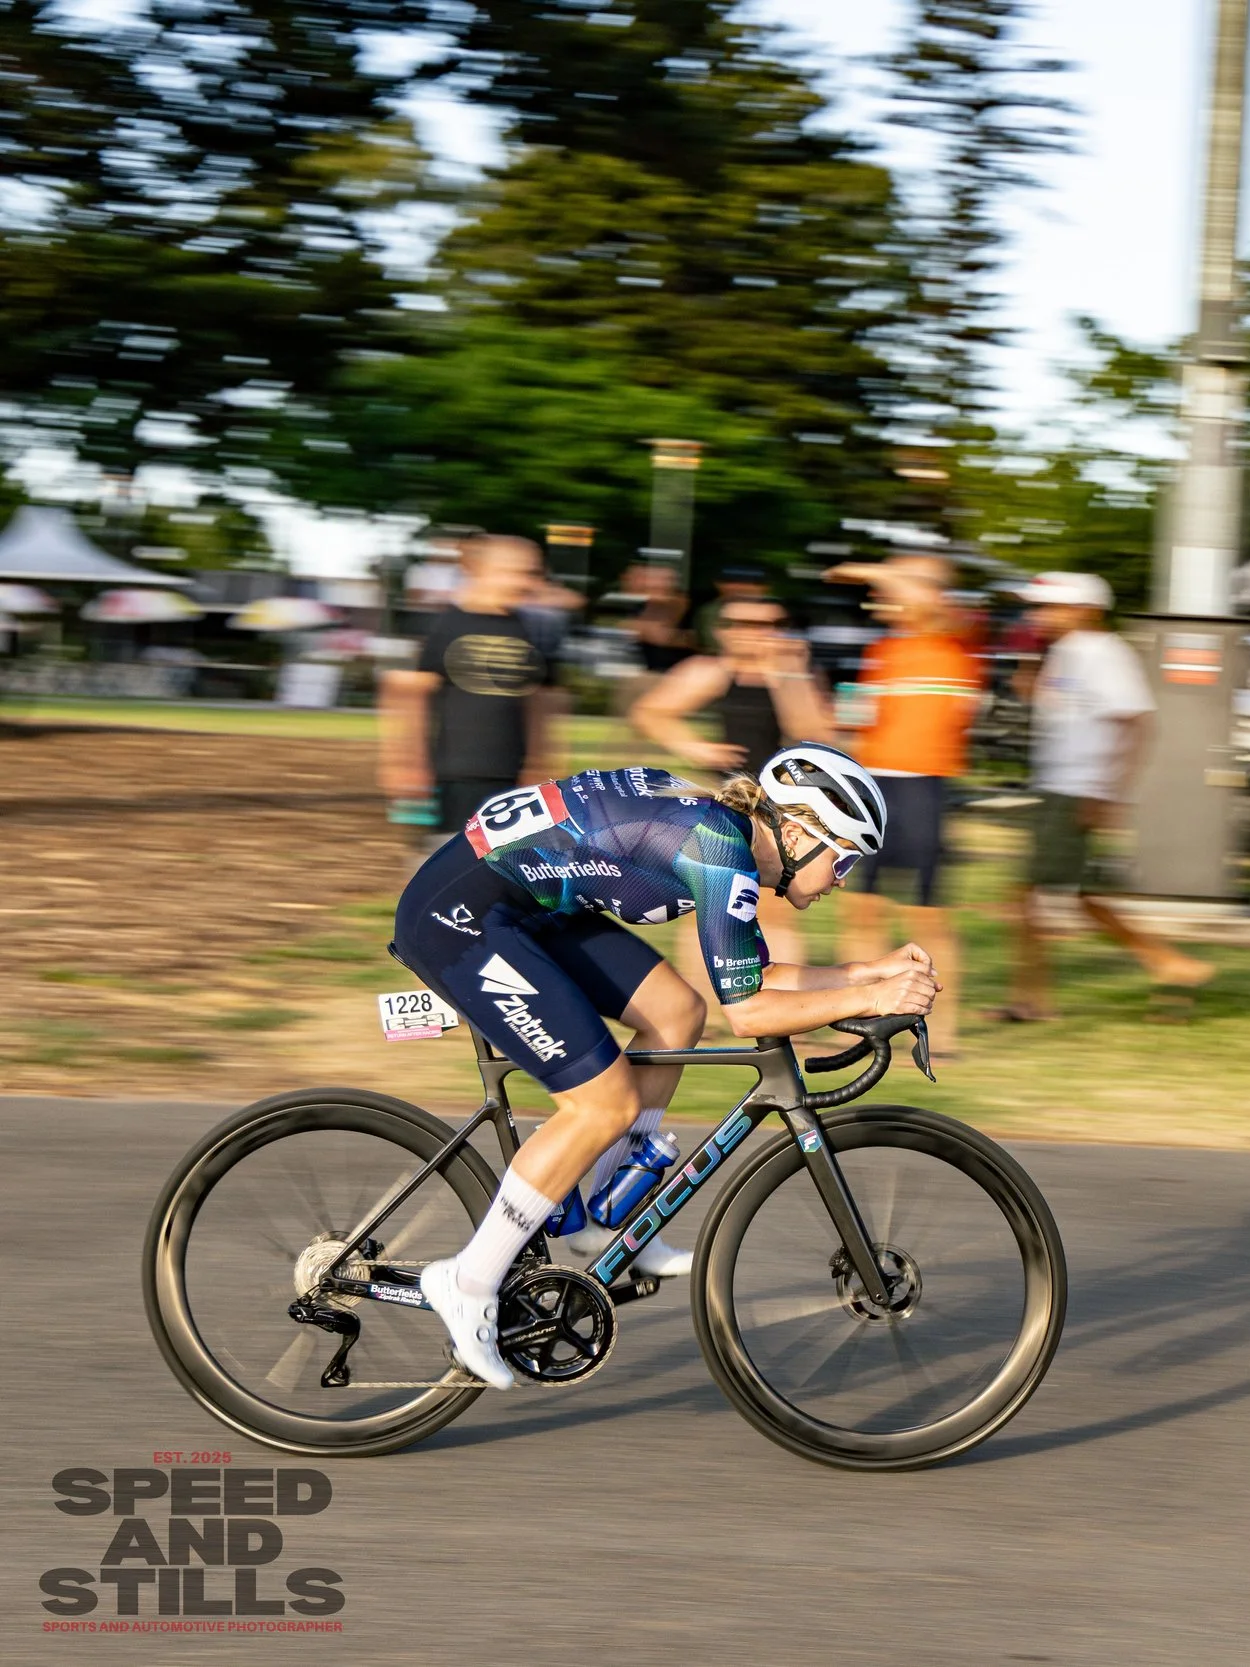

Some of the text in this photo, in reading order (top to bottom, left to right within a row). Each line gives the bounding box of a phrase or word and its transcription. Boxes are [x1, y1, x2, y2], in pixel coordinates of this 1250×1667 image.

[624, 766, 653, 798] ptrak
[481, 791, 545, 832] 65
[519, 859, 622, 883] Butterfields
[385, 993, 432, 1015] 1228
[493, 994, 566, 1061] Ziptrak
[595, 1108, 752, 1284] FOCUS
[370, 1284, 423, 1300] Butterfields
